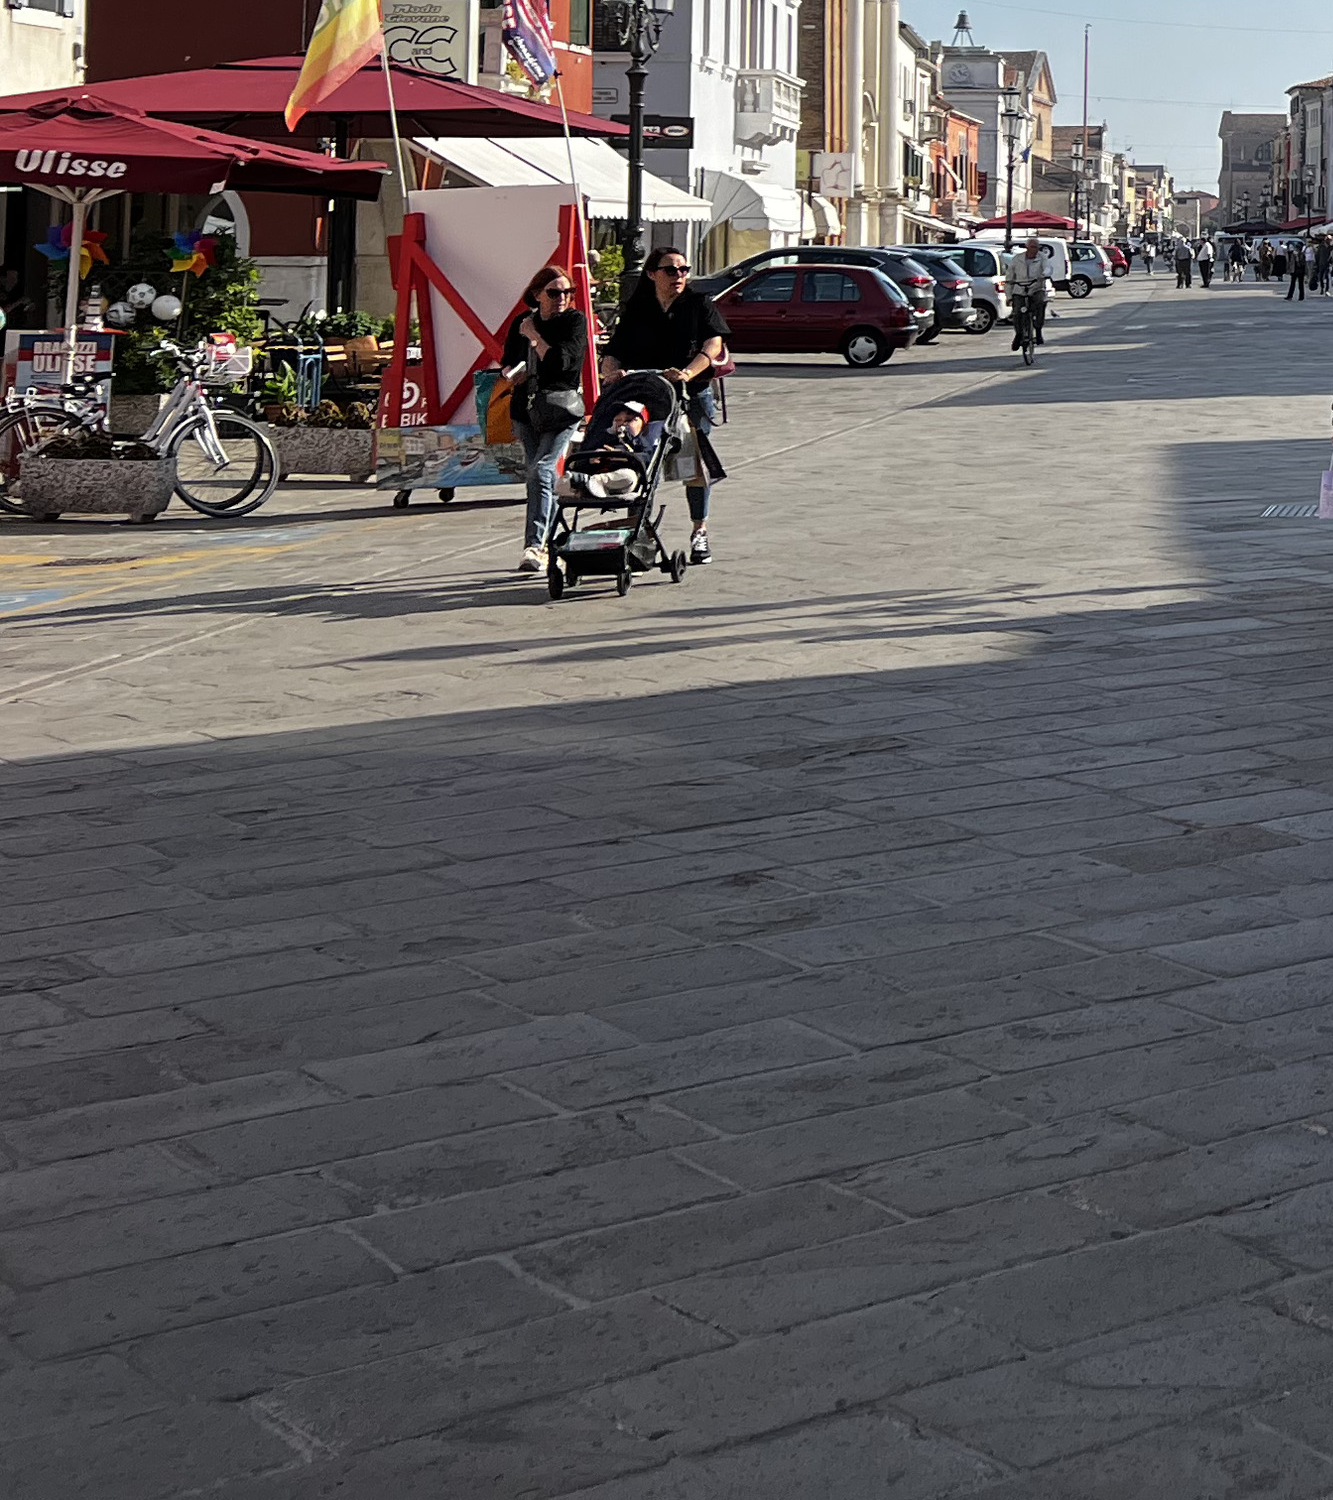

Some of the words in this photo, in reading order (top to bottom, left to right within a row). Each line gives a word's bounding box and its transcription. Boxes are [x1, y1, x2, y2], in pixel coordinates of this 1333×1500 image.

[393, 4, 443, 14] Moda
[385, 14, 450, 23] Giovane
[411, 46, 433, 56] and
[14, 149, 128, 178] Ulisse
[33, 354, 97, 372] ULISE
